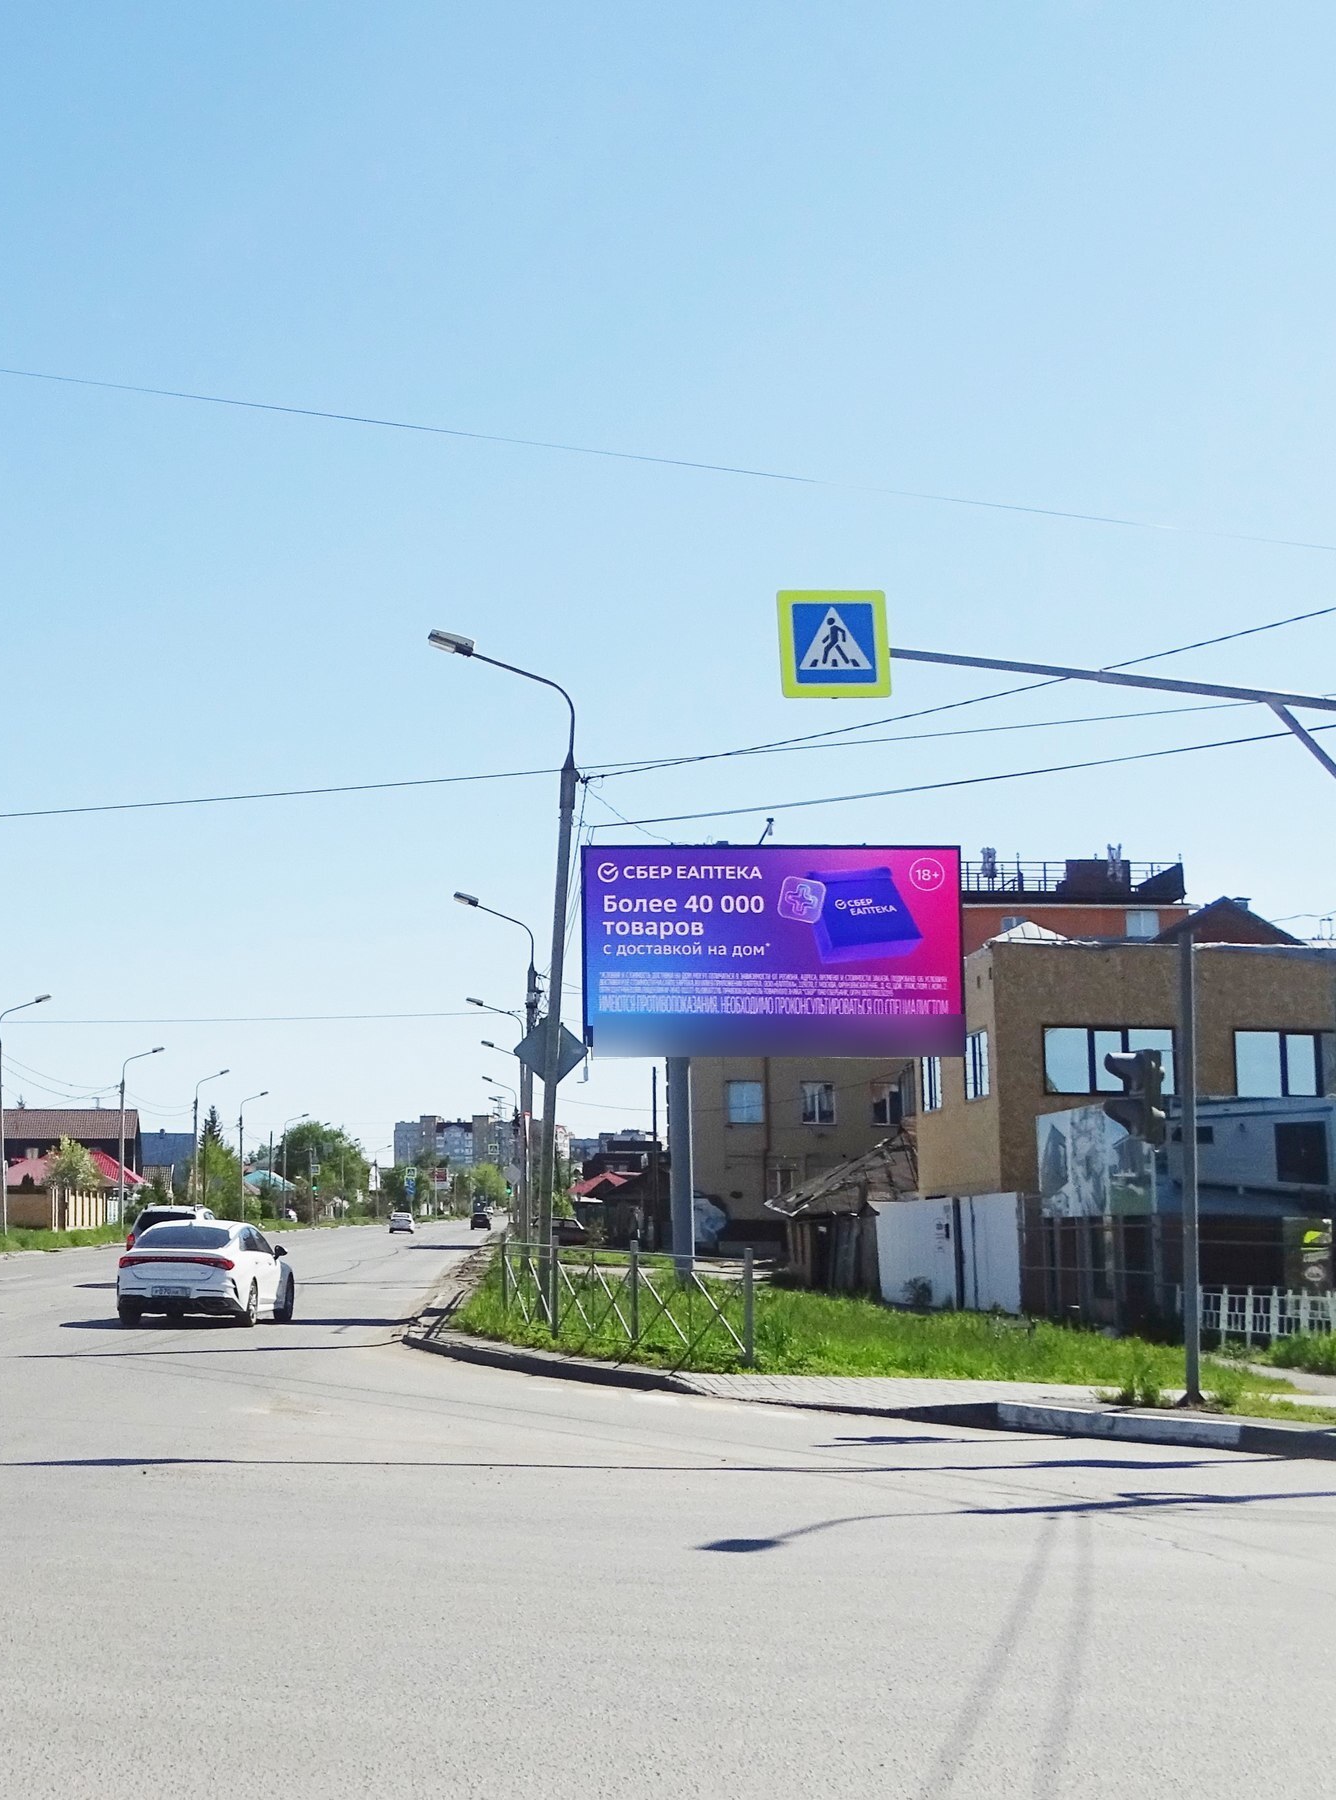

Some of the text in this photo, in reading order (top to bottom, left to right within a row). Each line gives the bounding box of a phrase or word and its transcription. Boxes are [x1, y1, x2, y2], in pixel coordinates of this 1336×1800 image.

[623, 865, 763, 880] СБЕР ЕАПТЕКА
[915, 869, 939, 881] 18+
[603, 894, 765, 914] Более 40 000
[847, 898, 873, 908] СБЕР
[850, 904, 897, 916] ЕАПТЕКА
[602, 920, 704, 940] товаров
[602, 944, 612, 955] с
[616, 942, 702, 957] доставкой
[708, 944, 727, 956] на
